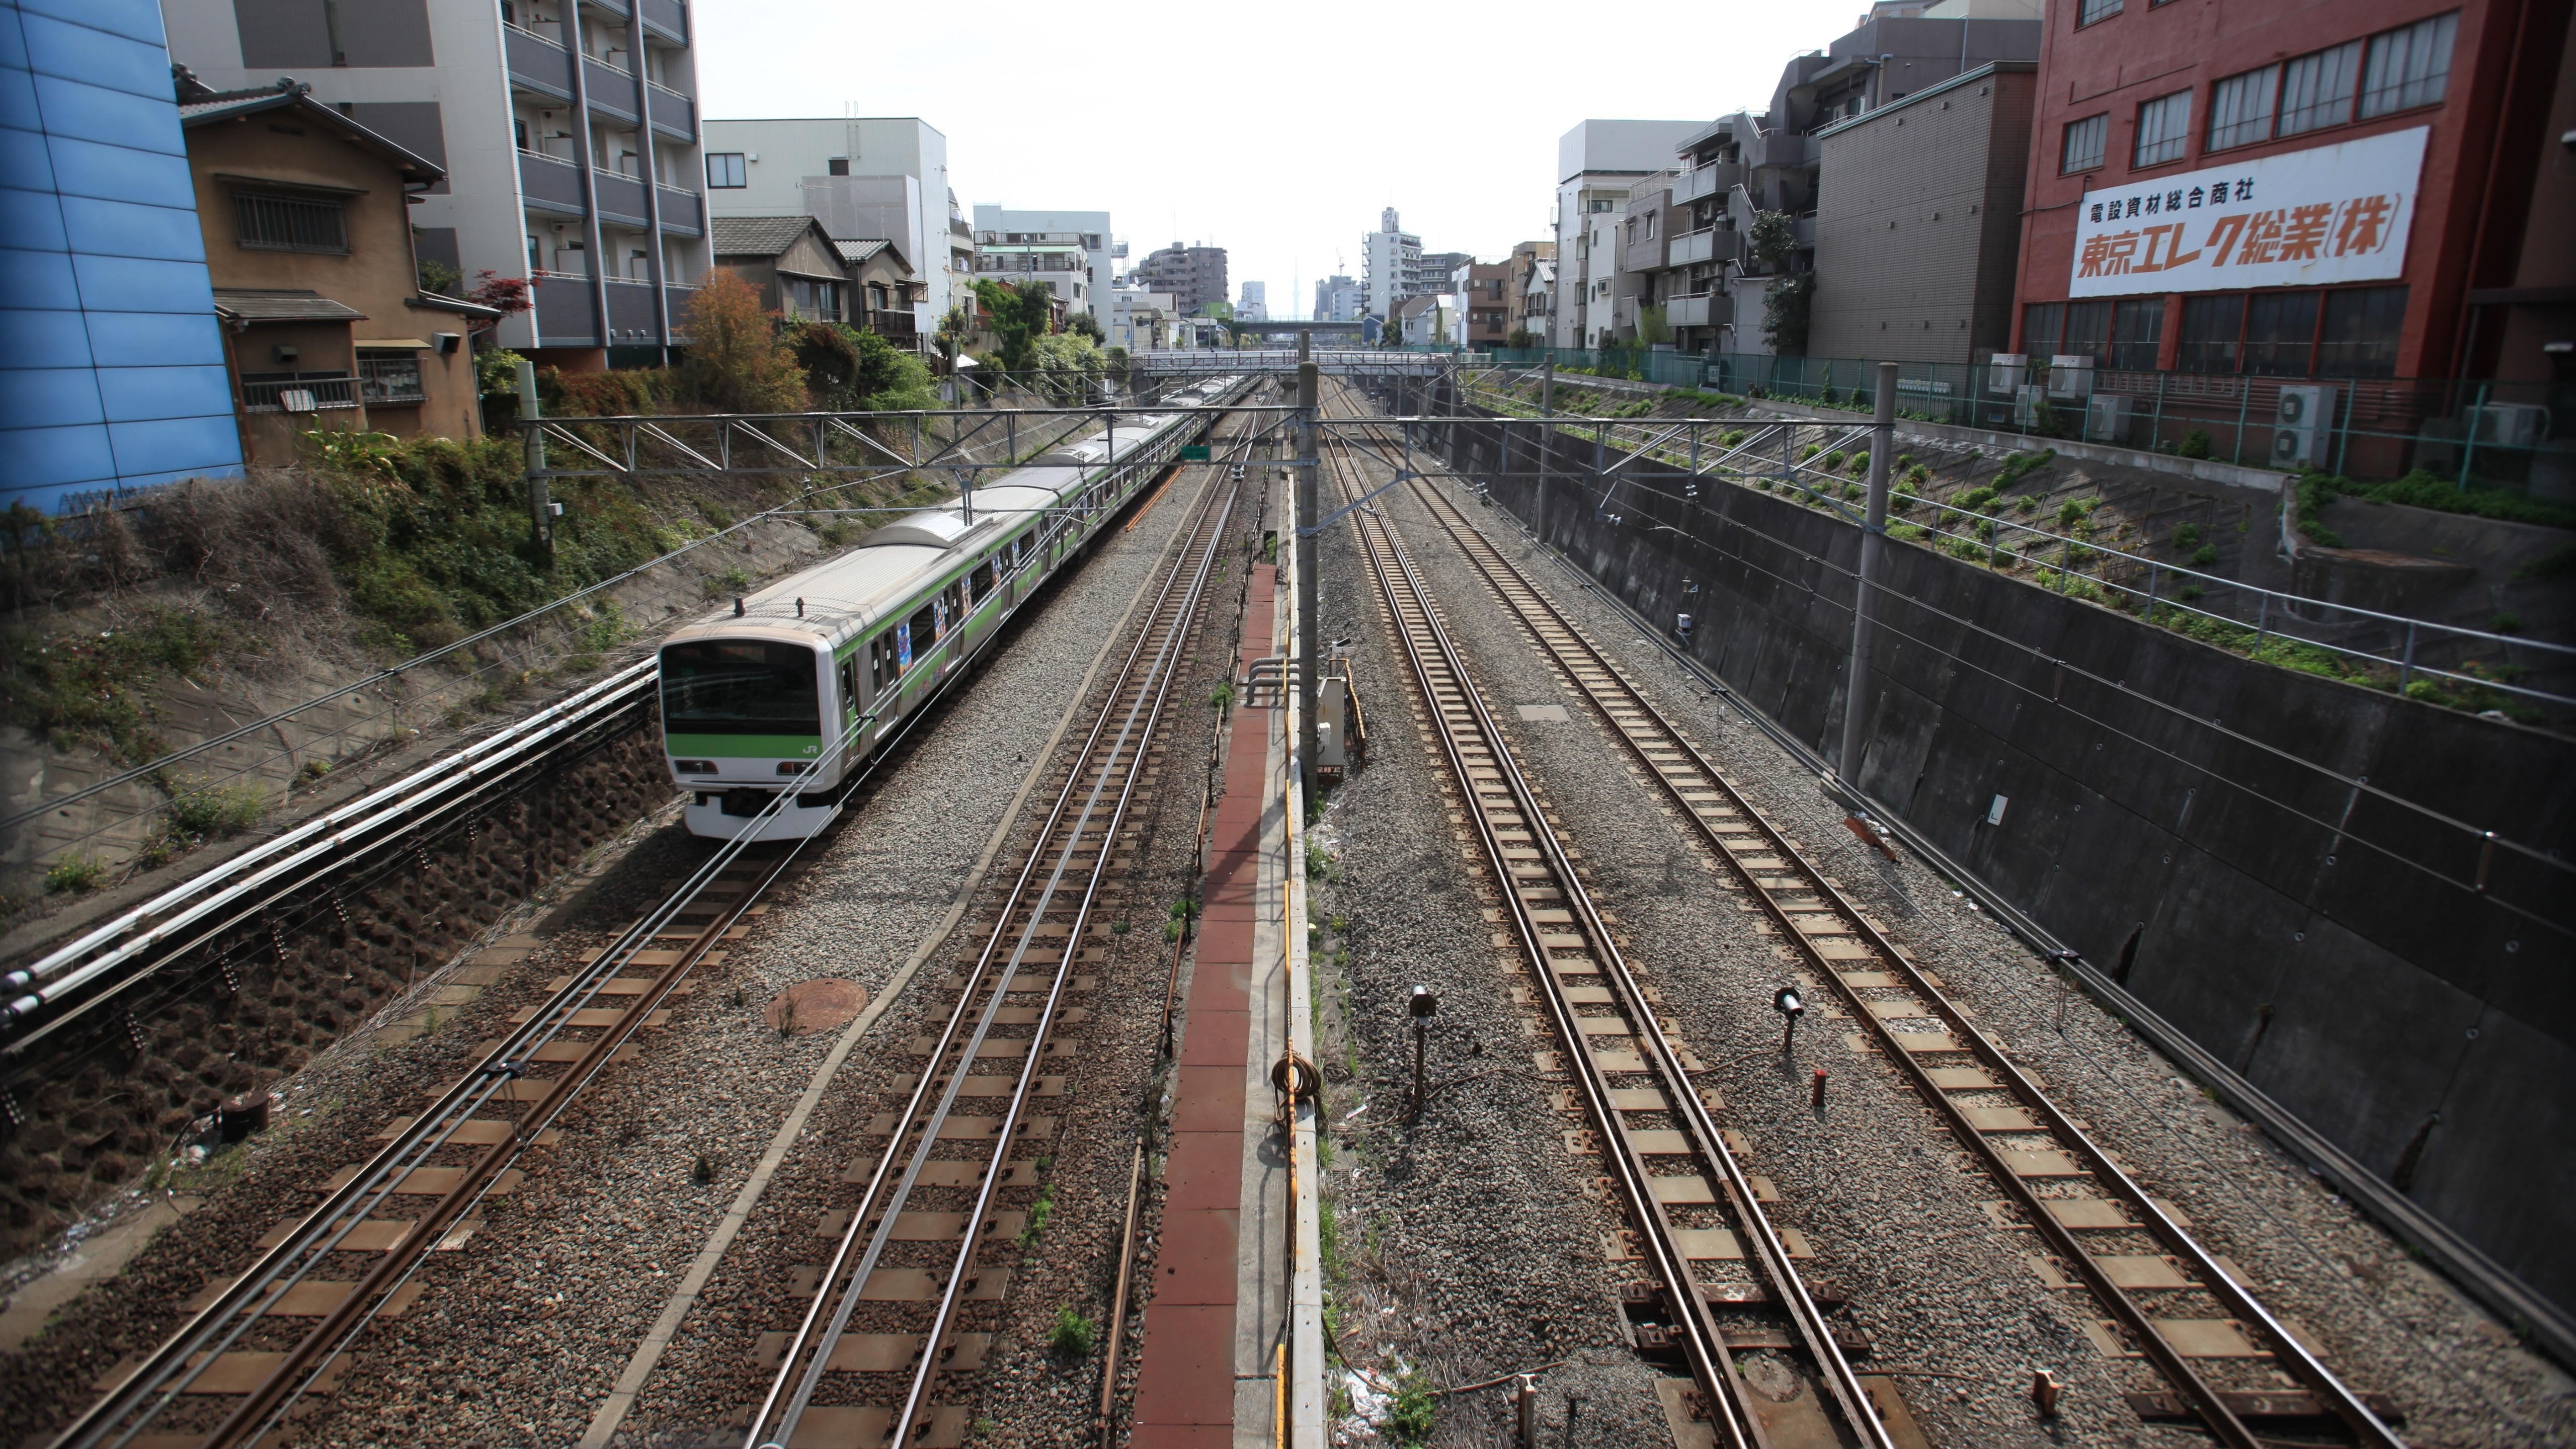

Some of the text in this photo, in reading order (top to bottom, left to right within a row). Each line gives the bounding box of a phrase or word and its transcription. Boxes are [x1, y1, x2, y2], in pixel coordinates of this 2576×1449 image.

[2090, 177, 2255, 223] 電設資材総合商社
[2077, 192, 2401, 278] 東京エレク総業(株)
[803, 746, 818, 754] JR
